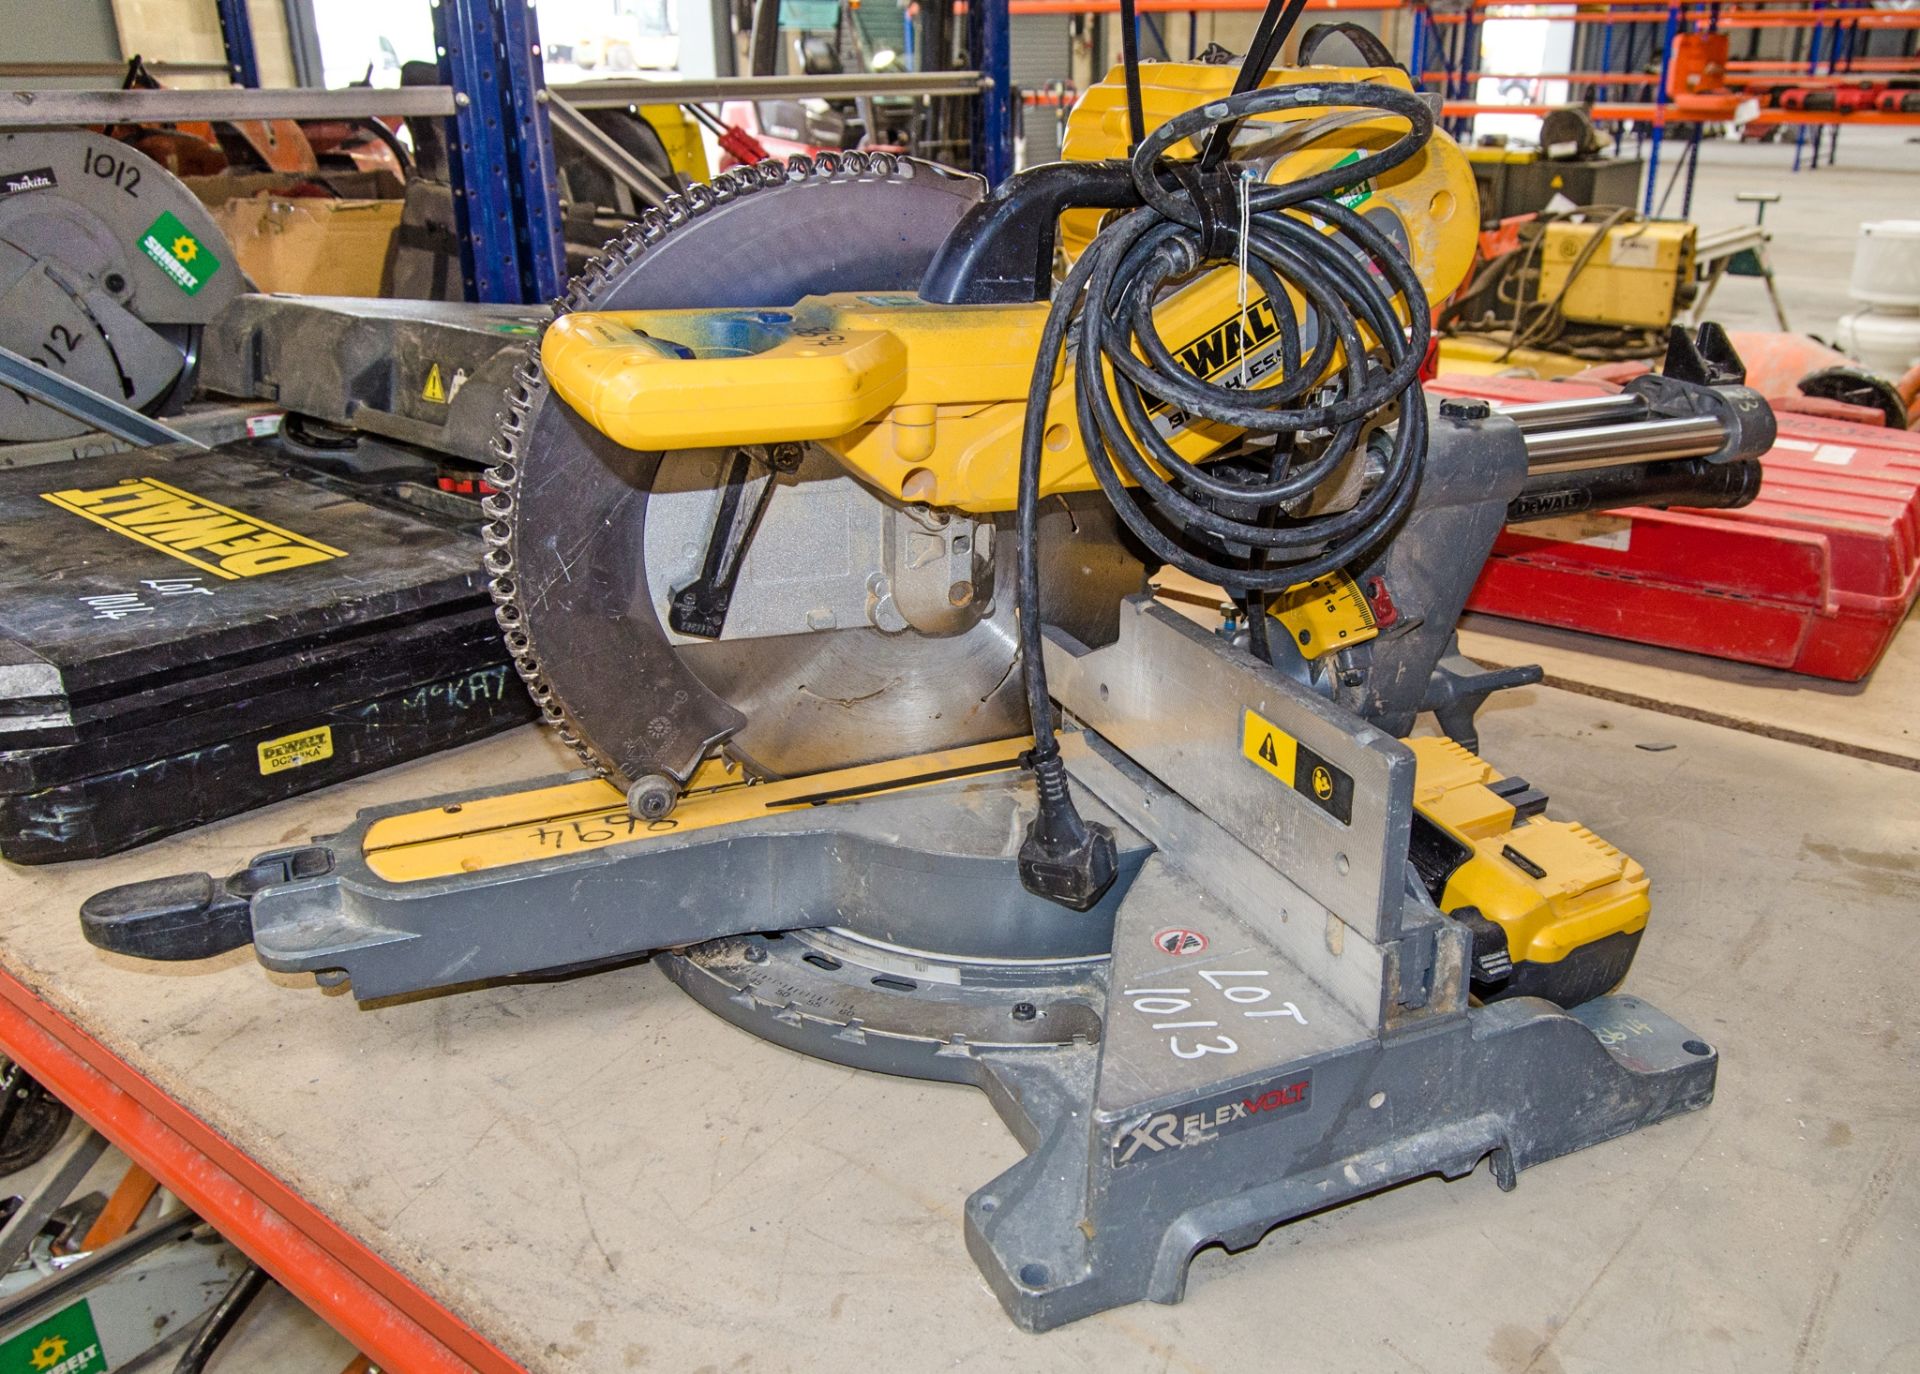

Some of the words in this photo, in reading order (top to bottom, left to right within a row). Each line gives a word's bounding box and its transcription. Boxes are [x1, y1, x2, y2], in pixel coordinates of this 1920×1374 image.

[84, 147, 141, 198] 1012
[144, 235, 198, 289] SUNBELT
[13, 324, 82, 404] 112
[79, 593, 154, 619] 1014
[1324, 599, 1336, 613] 15
[1338, 630, 1347, 638] 0
[1198, 970, 1309, 1025] LOT
[1123, 988, 1238, 1059] 1013
[1119, 1113, 1184, 1163] XR
